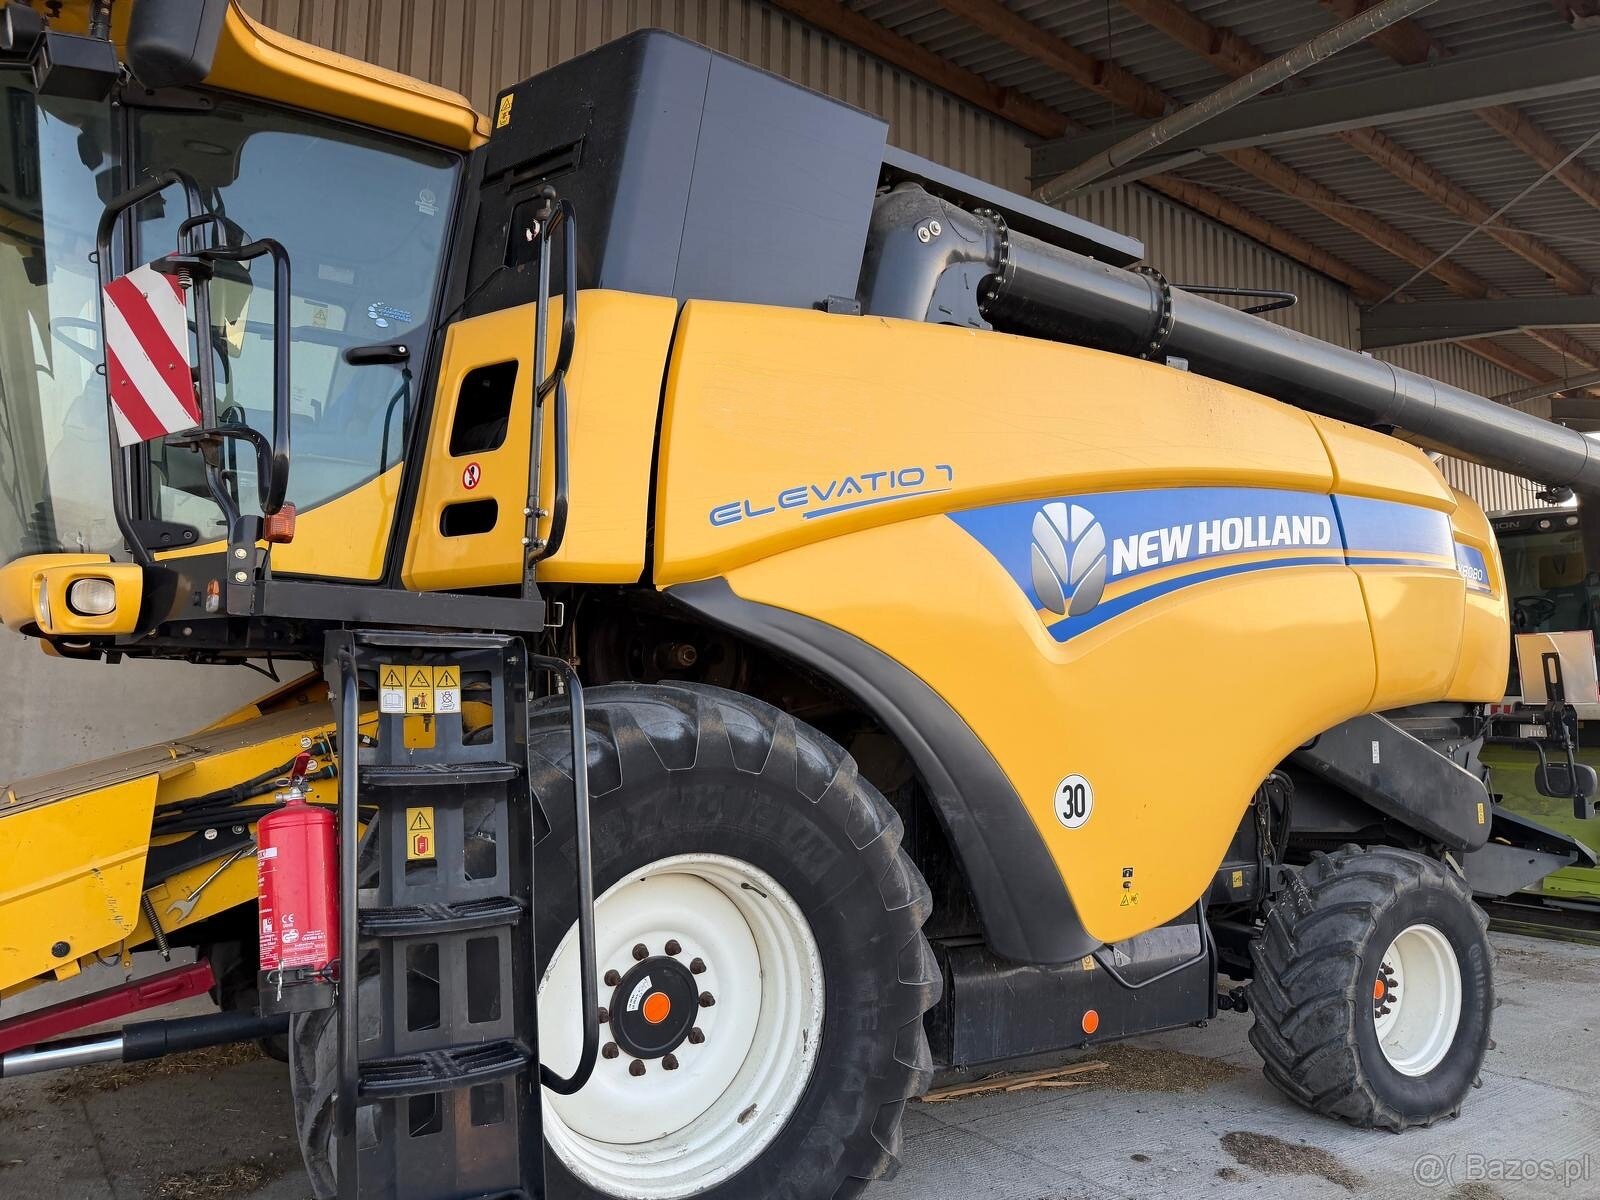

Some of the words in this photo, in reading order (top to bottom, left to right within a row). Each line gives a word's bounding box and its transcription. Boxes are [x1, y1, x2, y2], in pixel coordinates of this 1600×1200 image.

[1112, 524, 1192, 576] NEW
[1198, 515, 1331, 555] HOLLAND
[1062, 783, 1086, 819] 30
